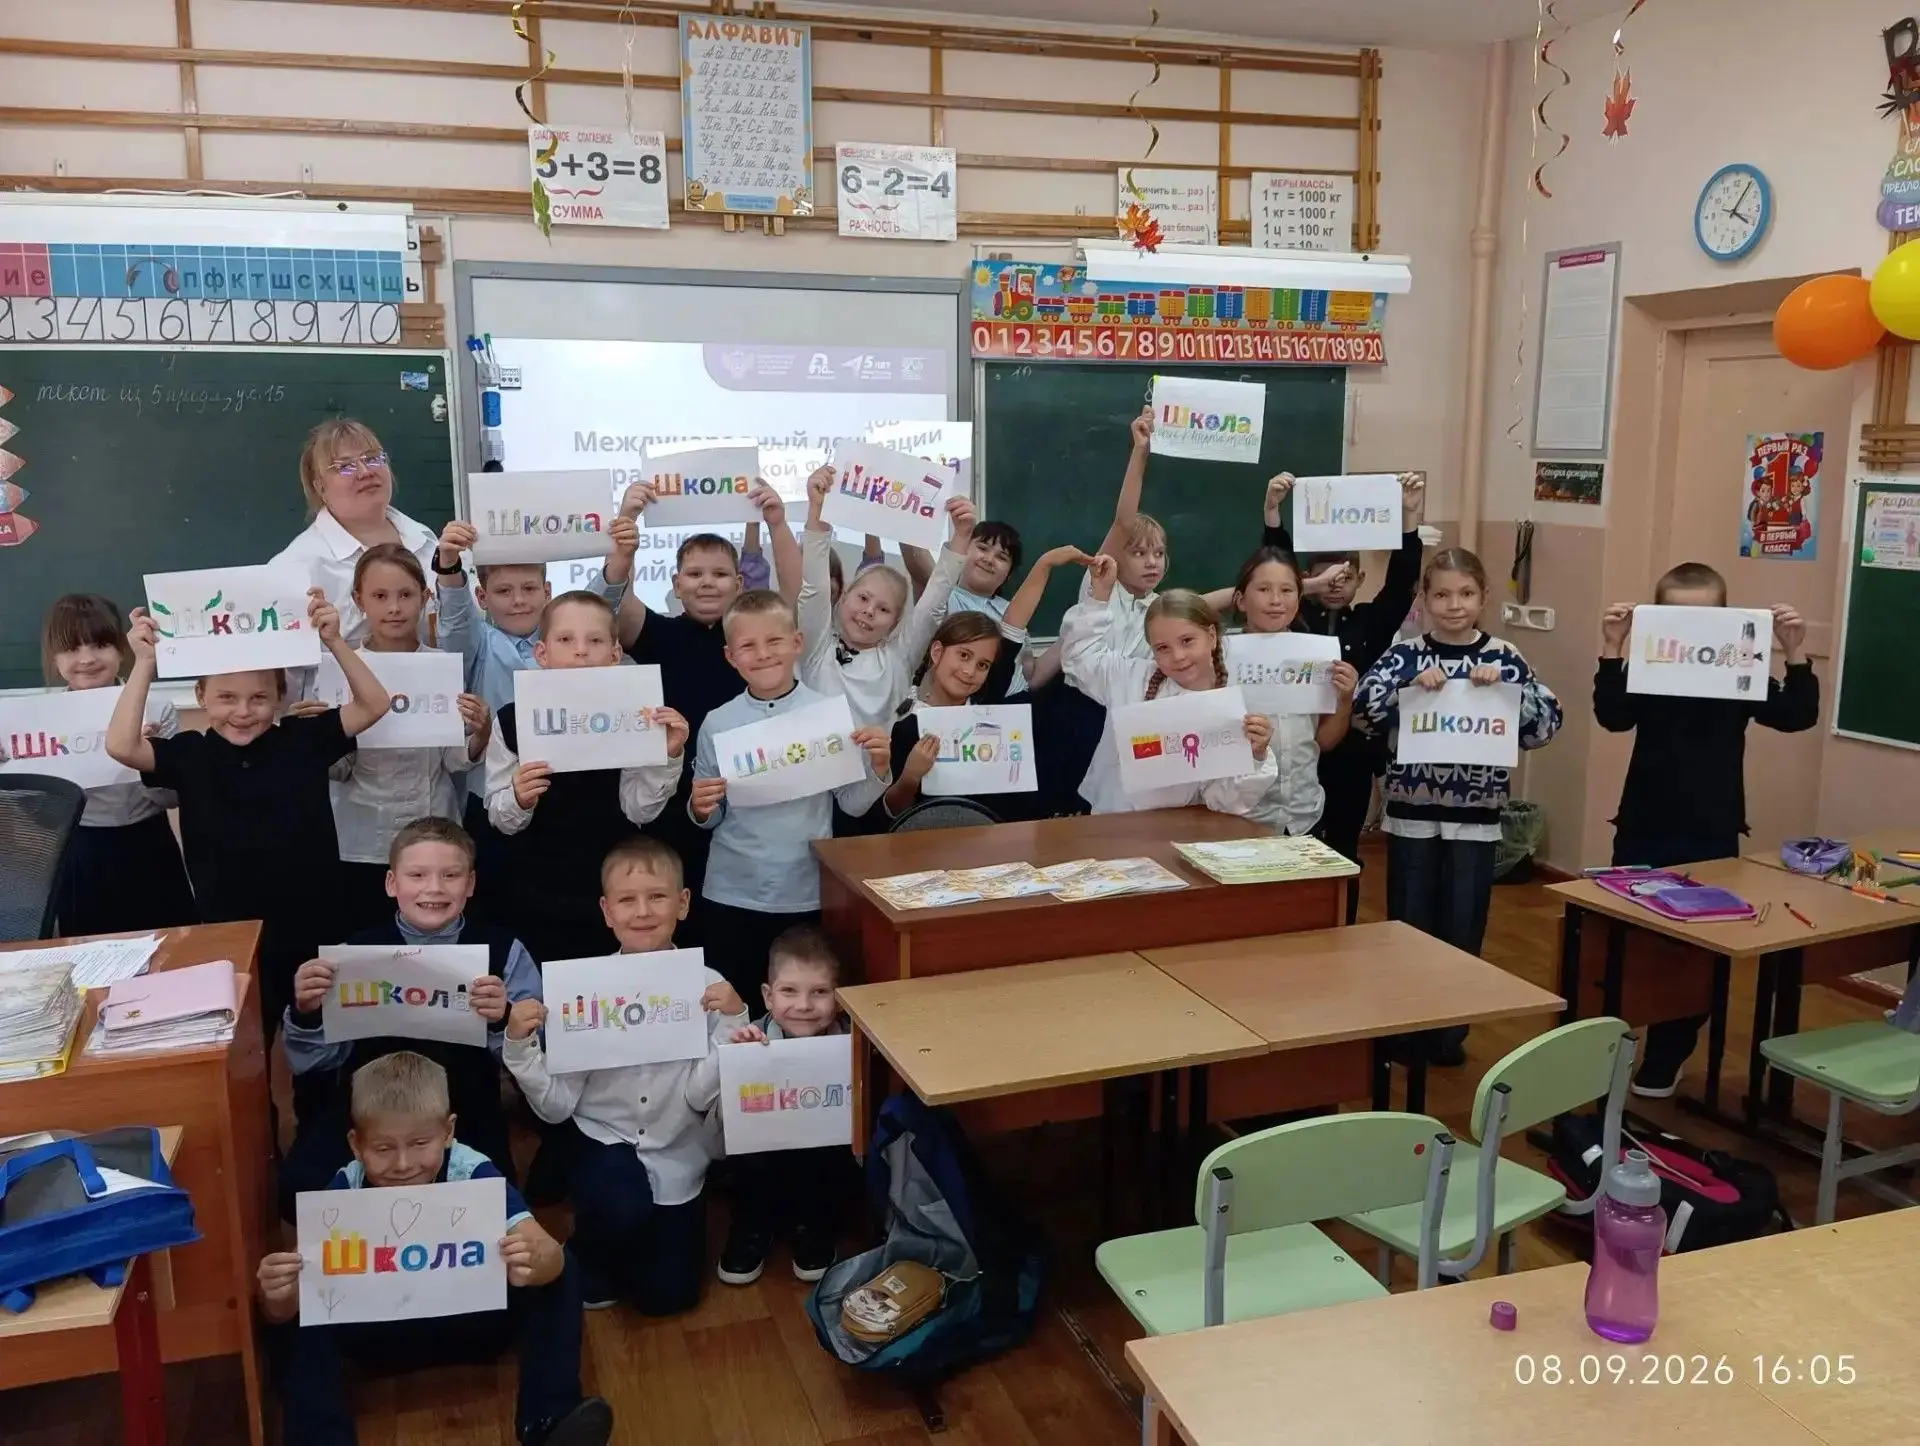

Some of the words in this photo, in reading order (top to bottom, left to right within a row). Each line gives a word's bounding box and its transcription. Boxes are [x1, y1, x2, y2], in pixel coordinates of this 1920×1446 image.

[687, 19, 805, 48] АЛФАВИТ
[536, 148, 662, 184] 5+3=8
[841, 165, 952, 198] 6-2=4
[1270, 179, 1299, 188] МЕРЫ
[1299, 181, 1334, 189] МАССЫ
[1263, 190, 1268, 200] 1
[1273, 192, 1279, 201] т
[1299, 190, 1326, 203] 1000
[1330, 194, 1342, 203] кг
[552, 204, 604, 219] СУММА
[1263, 207, 1269, 217] 1
[1273, 209, 1285, 218] кг
[1299, 207, 1327, 219] 1000
[1263, 223, 1269, 234] 1
[1299, 224, 1320, 236] 100
[1323, 228, 1334, 237] кг
[31, 270, 46, 285] е
[183, 271, 197, 287] п
[204, 267, 224, 293] ф
[232, 273, 244, 288] к
[251, 273, 264, 288] т
[272, 274, 290, 289] ш
[298, 275, 310, 290] с
[320, 275, 332, 290] х
[340, 276, 355, 294] ц
[363, 277, 376, 291] ч
[27, 297, 56, 340] 3
[67, 297, 99, 340] 4
[111, 297, 143, 341] 5
[159, 298, 184, 341] 6
[200, 298, 231, 342] 7
[250, 300, 274, 343] 8
[288, 301, 316, 343] 9
[339, 302, 399, 344] 10
[974, 327, 990, 352] 0
[997, 328, 1013, 352] 1
[1016, 328, 1032, 354] 2
[1037, 328, 1051, 354] 3
[1056, 329, 1074, 355] 4
[1079, 330, 1093, 355] 5
[1097, 331, 1114, 356] 6
[1118, 332, 1133, 356] 7
[1139, 331, 1154, 357] 8
[1159, 332, 1174, 357] 9
[1176, 333, 1194, 357] 10
[1197, 334, 1214, 358] 11
[1216, 334, 1235, 359] 12
[1235, 335, 1253, 359] 13
[1254, 335, 1272, 360] 14
[1273, 336, 1291, 359] 15
[1291, 336, 1310, 360] 16
[1310, 336, 1327, 360] 17
[1329, 337, 1346, 361] 18
[1347, 337, 1364, 361] 19
[1365, 338, 1383, 361] 20
[1162, 404, 1252, 434] Школа
[1757, 440, 1790, 457] ПЕРВЫЙ
[1791, 443, 1808, 455] РАЗ
[654, 473, 749, 497] Школа
[840, 467, 936, 518] Школа
[1304, 480, 1392, 525] Школа
[488, 509, 601, 536] Школа
[533, 707, 650, 736] Школа
[1411, 711, 1506, 736] Школа
[11, 731, 108, 760] Школ
[733, 733, 844, 778] Школа
[340, 981, 471, 1012] Школа
[562, 993, 691, 1033] Школа
[739, 1082, 852, 1113] Школ
[322, 1231, 485, 1276] Школа
